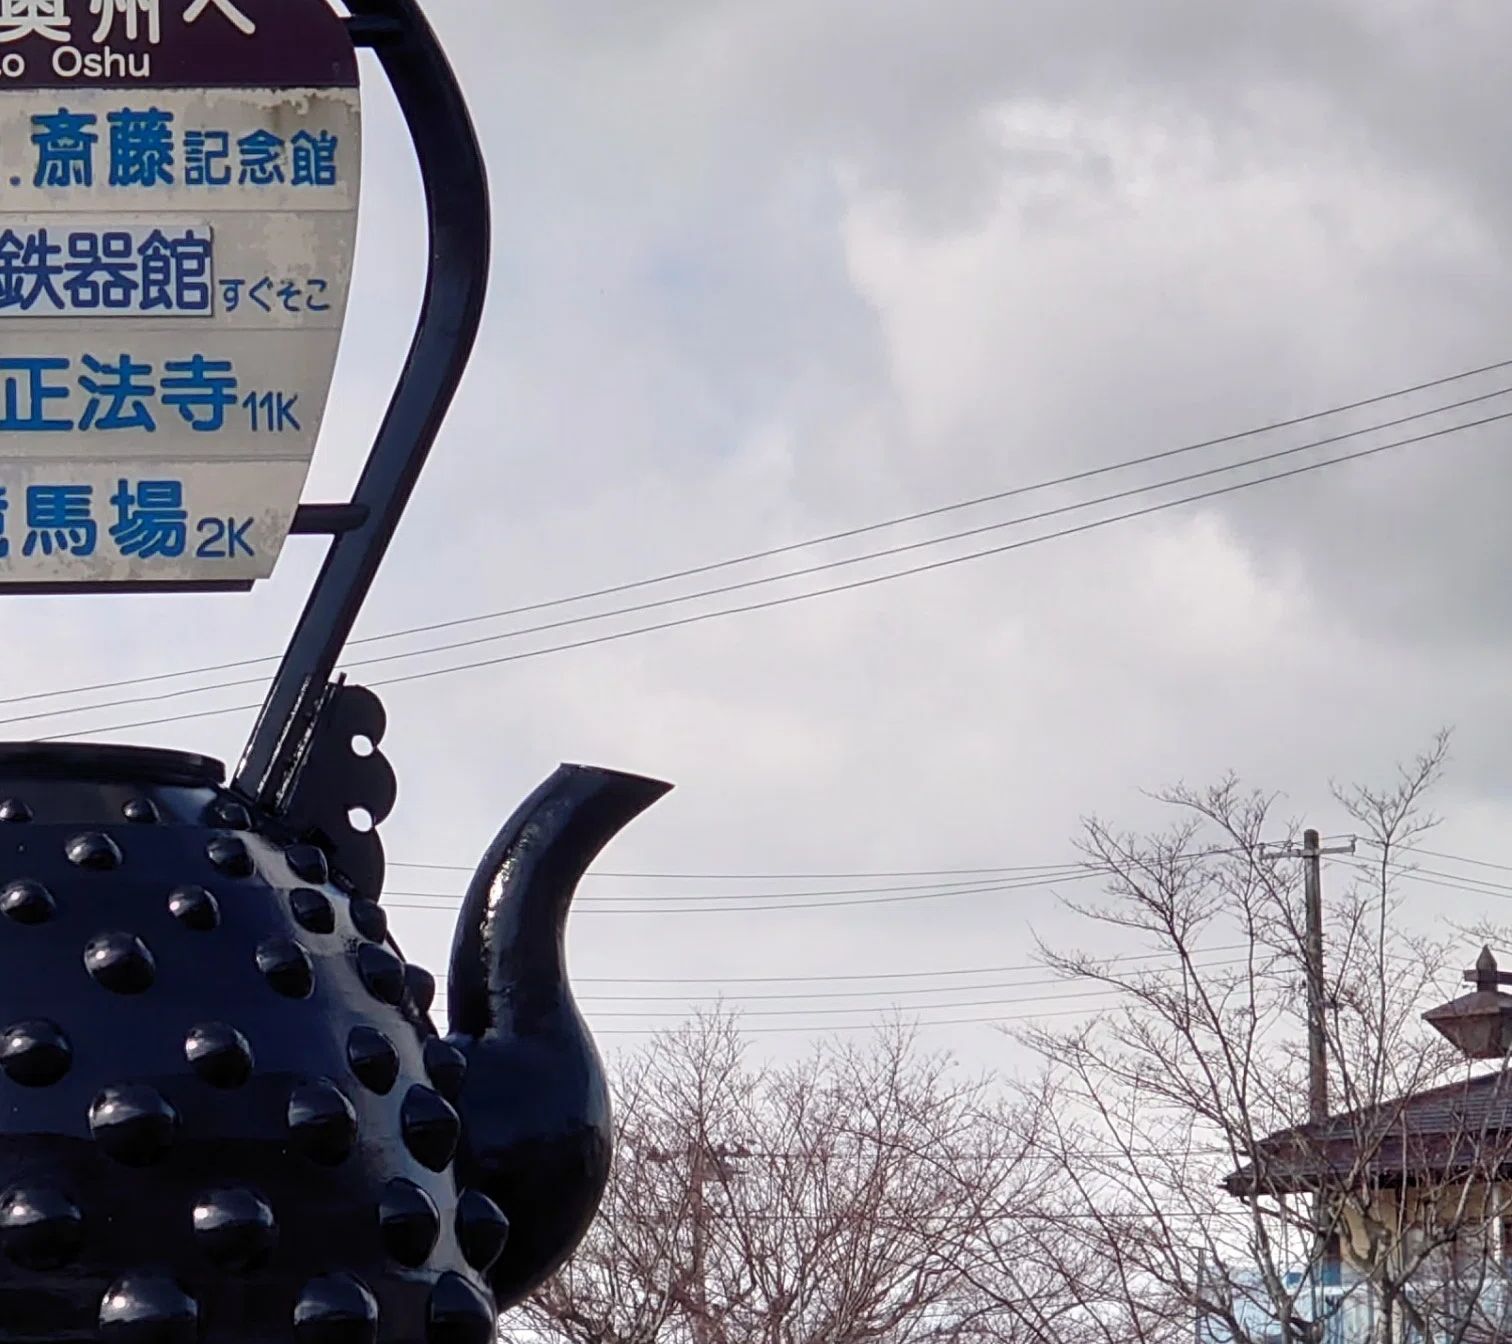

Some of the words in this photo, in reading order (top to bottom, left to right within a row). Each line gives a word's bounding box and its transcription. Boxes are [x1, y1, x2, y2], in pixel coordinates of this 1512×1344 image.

[52, 47, 151, 79] Oshu
[220, 278, 332, 312] すぐそこ
[196, 517, 255, 558] 2K
